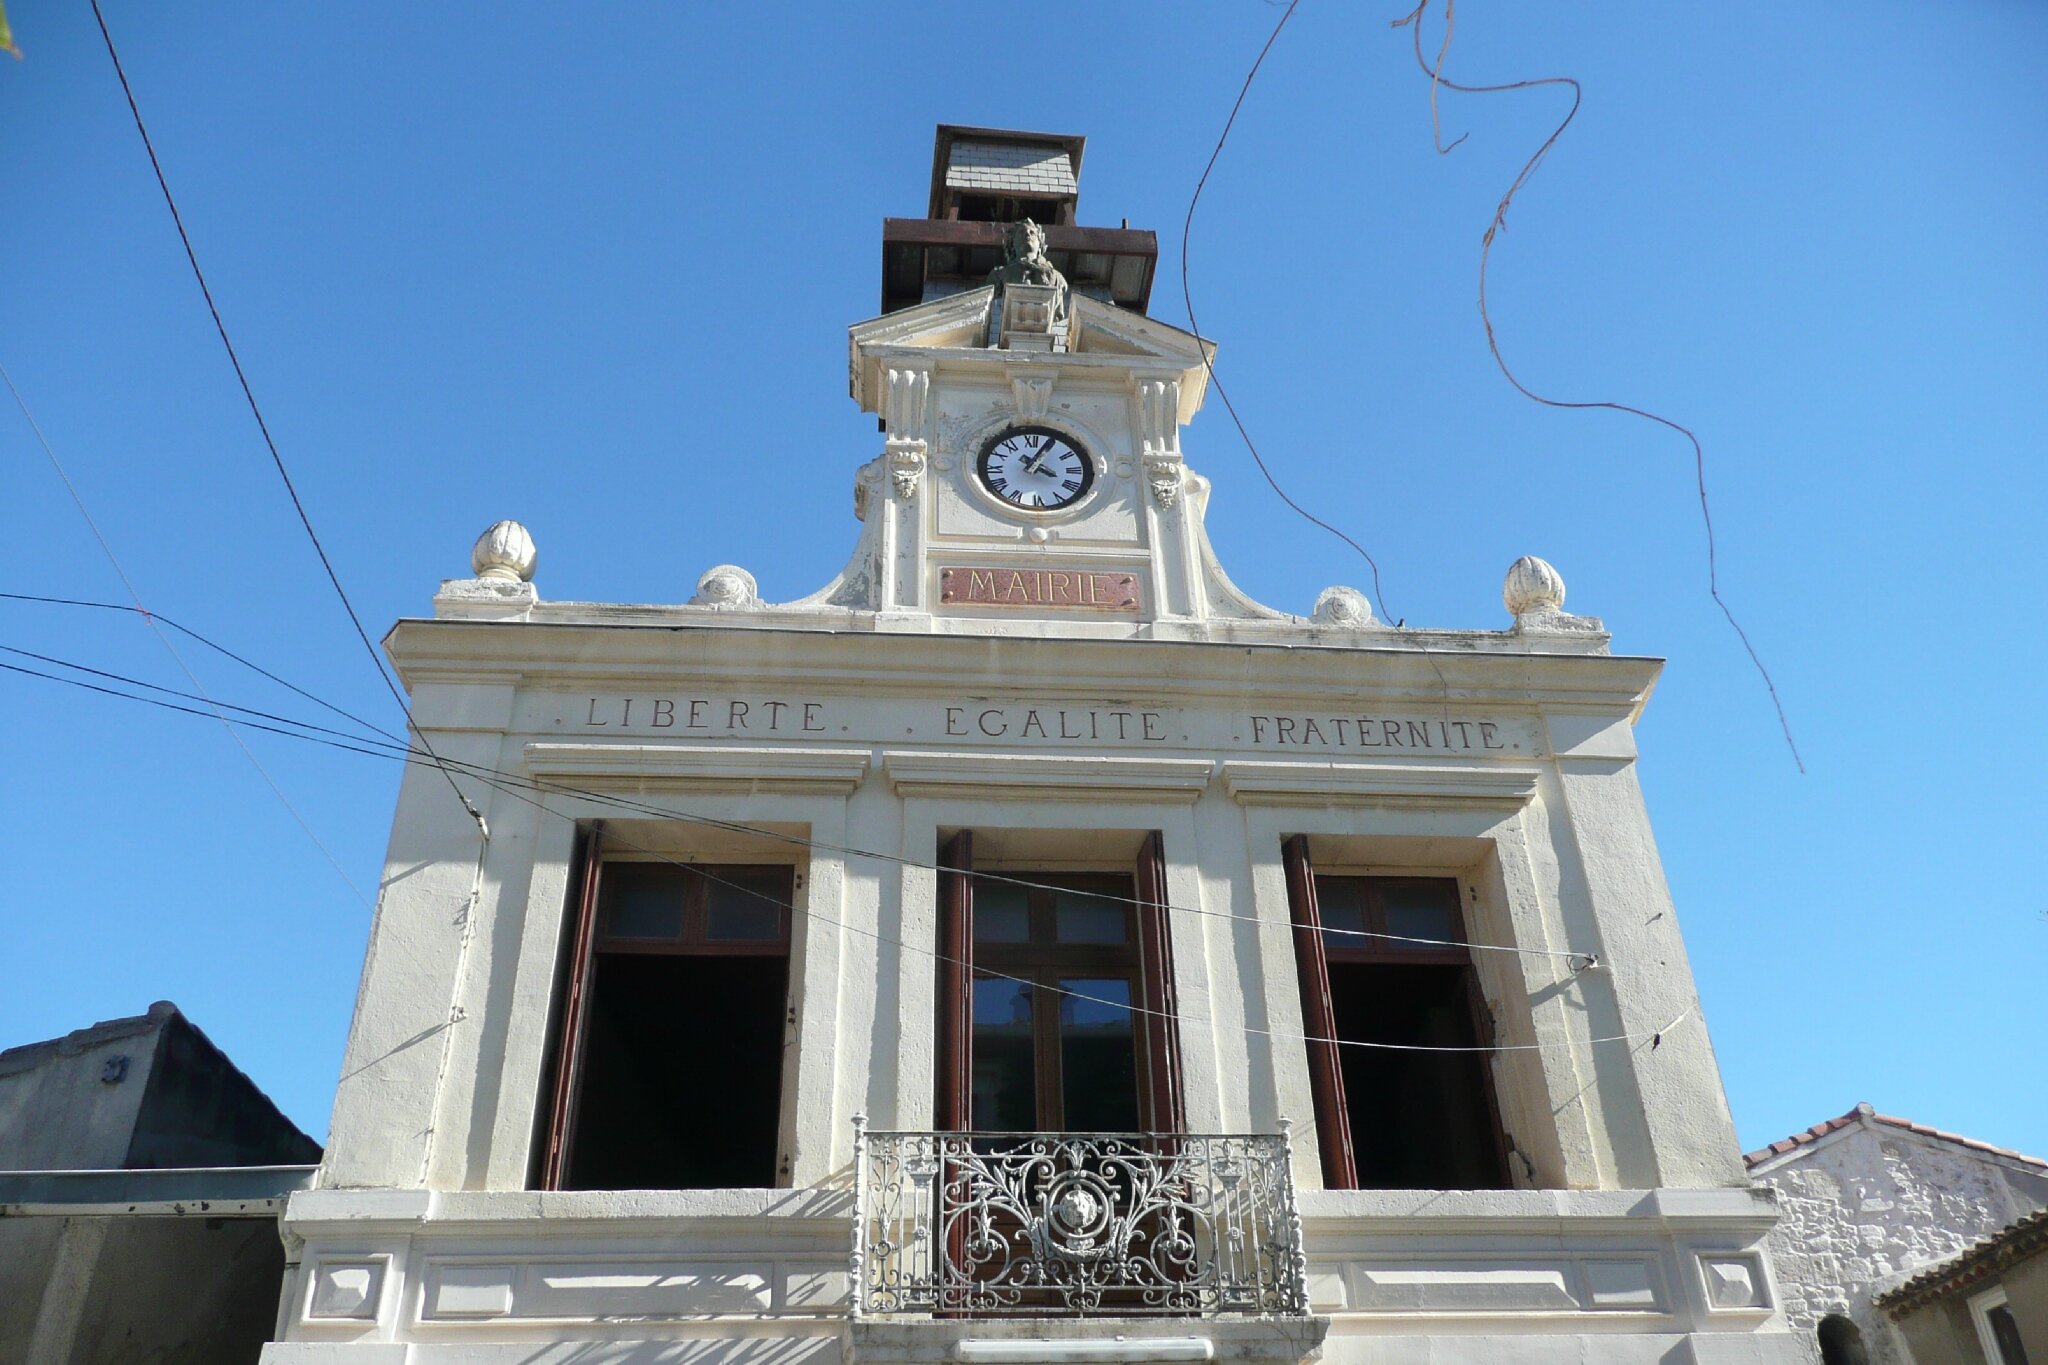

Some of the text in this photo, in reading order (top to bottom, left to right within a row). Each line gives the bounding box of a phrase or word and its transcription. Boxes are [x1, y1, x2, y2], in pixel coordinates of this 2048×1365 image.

[1025, 435, 1038, 448] XII
[968, 570, 1114, 604] MAIRIE
[585, 699, 1504, 749] LIBERTE EGALITE FRATERNITE
